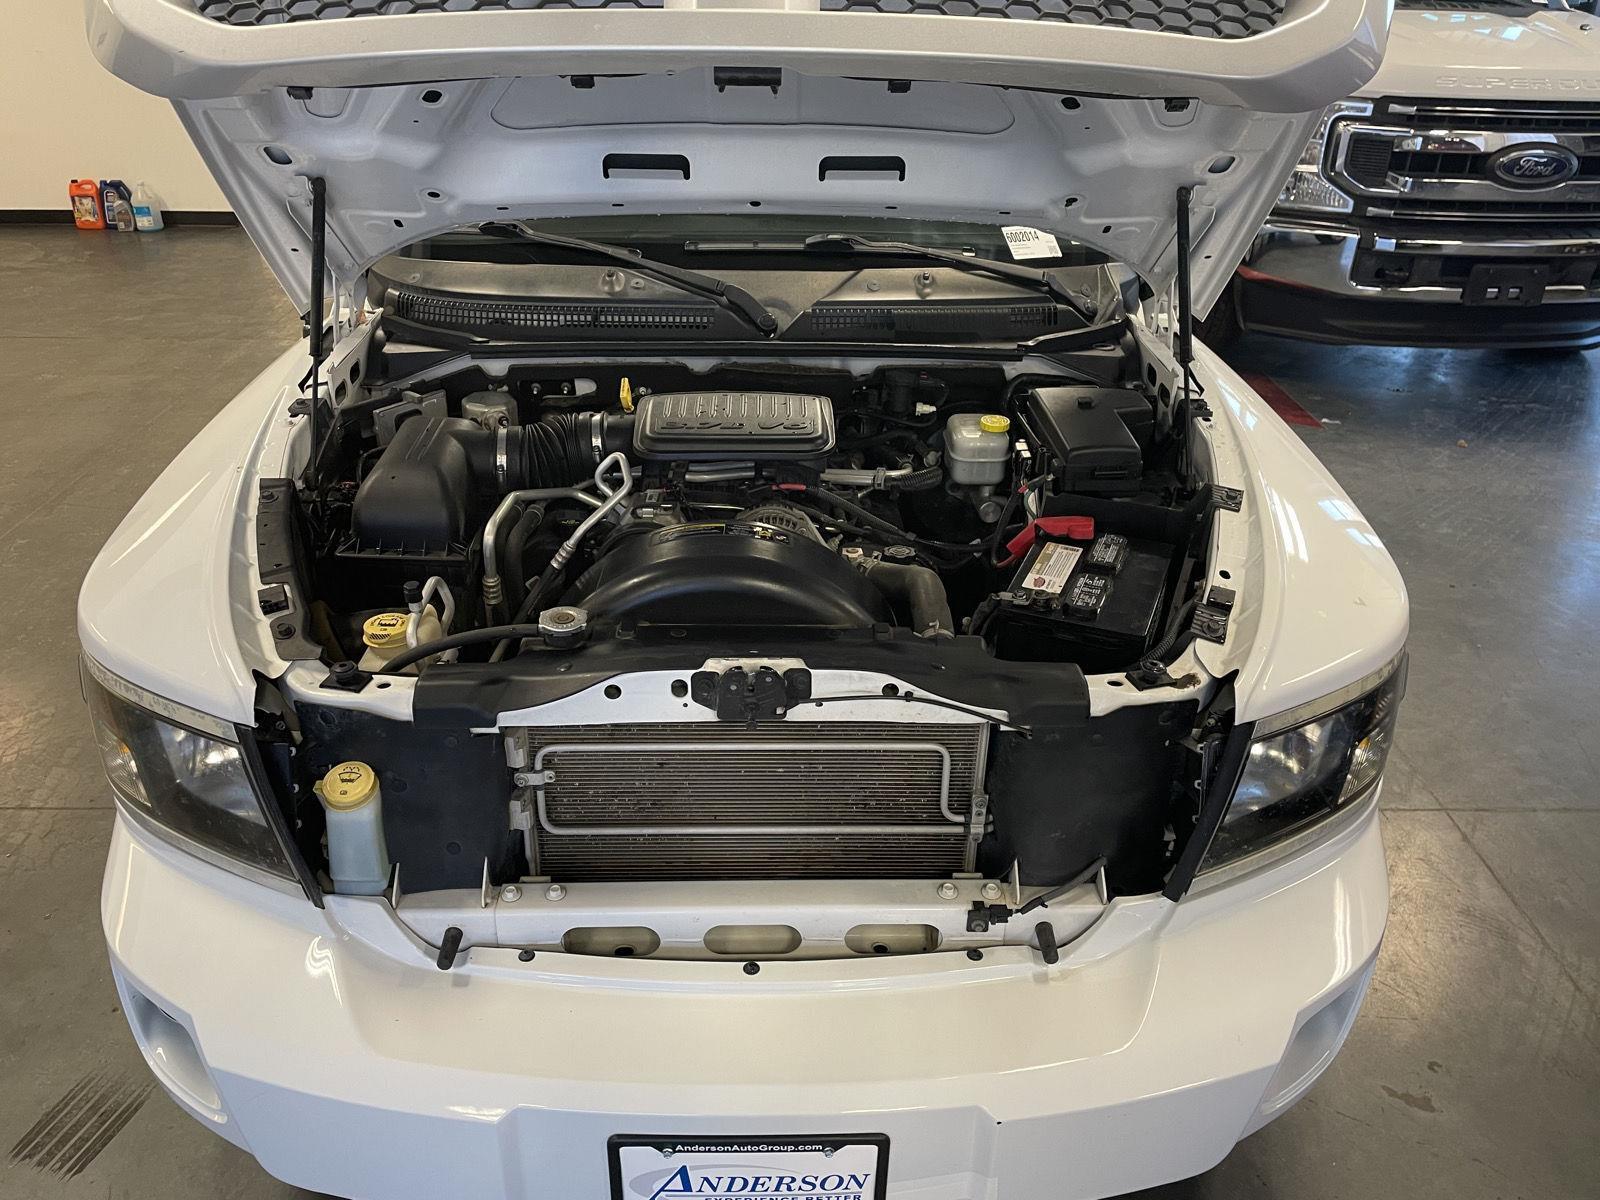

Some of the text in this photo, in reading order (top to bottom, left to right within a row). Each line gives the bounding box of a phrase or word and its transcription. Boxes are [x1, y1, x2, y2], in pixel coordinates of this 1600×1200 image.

[1435, 76, 1553, 90] SUPER
[1513, 156, 1557, 176] Ford
[1005, 229, 1040, 243] 6002014
[675, 1144, 823, 1152] AndersonAutoGroup.com
[648, 1164, 871, 1200] ANDERSON
